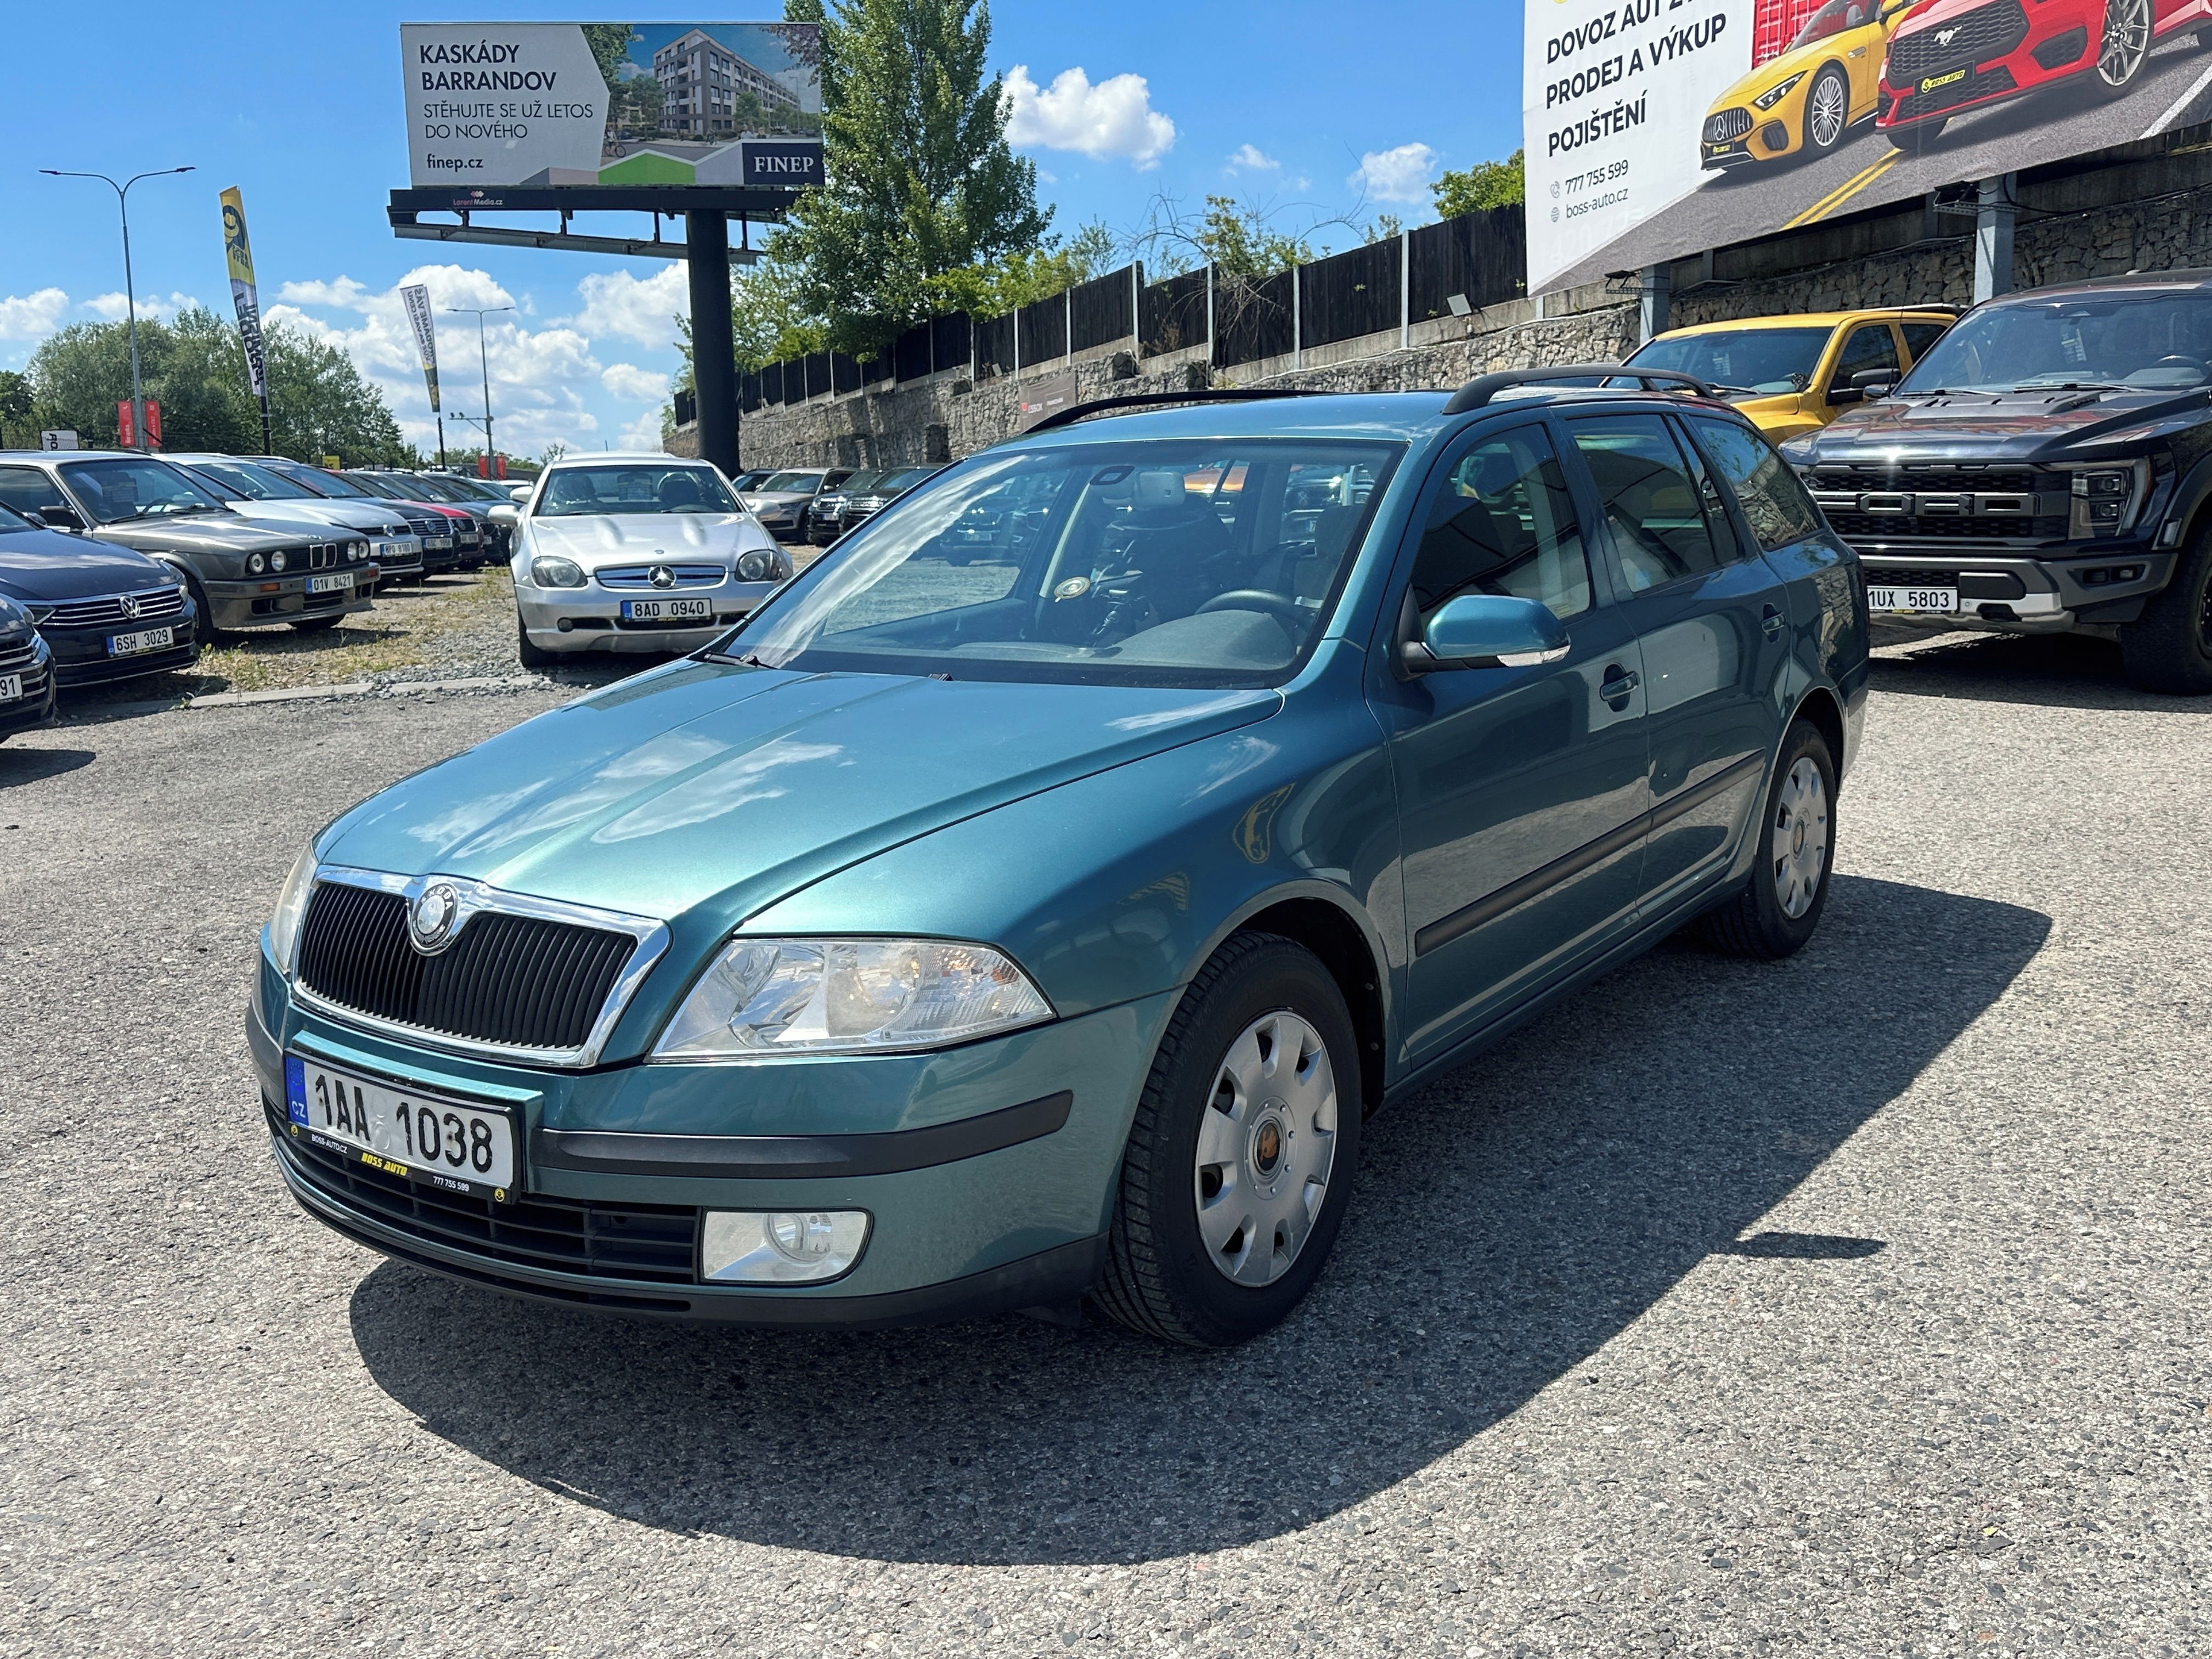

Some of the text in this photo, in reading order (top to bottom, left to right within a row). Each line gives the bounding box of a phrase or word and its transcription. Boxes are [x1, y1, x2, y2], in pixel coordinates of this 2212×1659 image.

[1547, 10, 1616, 64] DOVOZ
[420, 40, 520, 64] KASKÁDY
[1547, 13, 1726, 109] PRODEJ A VÝKUP
[422, 71, 556, 91] BARRANDOV
[424, 100, 593, 118] STĚHUJTE SE UŽ LETOS
[425, 121, 528, 138] DO NOVÉHO
[1549, 89, 1648, 157] POJIŠTĚNÍ
[427, 153, 483, 172] finep.cz
[754, 157, 814, 172] FINEP
[1565, 160, 1628, 194] 777 755 599
[1566, 188, 1628, 218] boss-auto.cz
[314, 575, 351, 591] 01V 8421
[635, 601, 704, 617] 8AD 0940
[1869, 591, 1949, 607] 1UX 5803
[116, 629, 168, 651] 6SH 3029
[0, 678, 15, 696] 91
[291, 1101, 306, 1118] CZ
[315, 1074, 493, 1174] 1AA 1038
[311, 1133, 347, 1154] BOSS-AUTO.CZ
[361, 1152, 382, 1168] BOSS
[383, 1161, 408, 1177] AUTO
[444, 1179, 456, 1189] 755
[457, 1182, 470, 1192] 599
